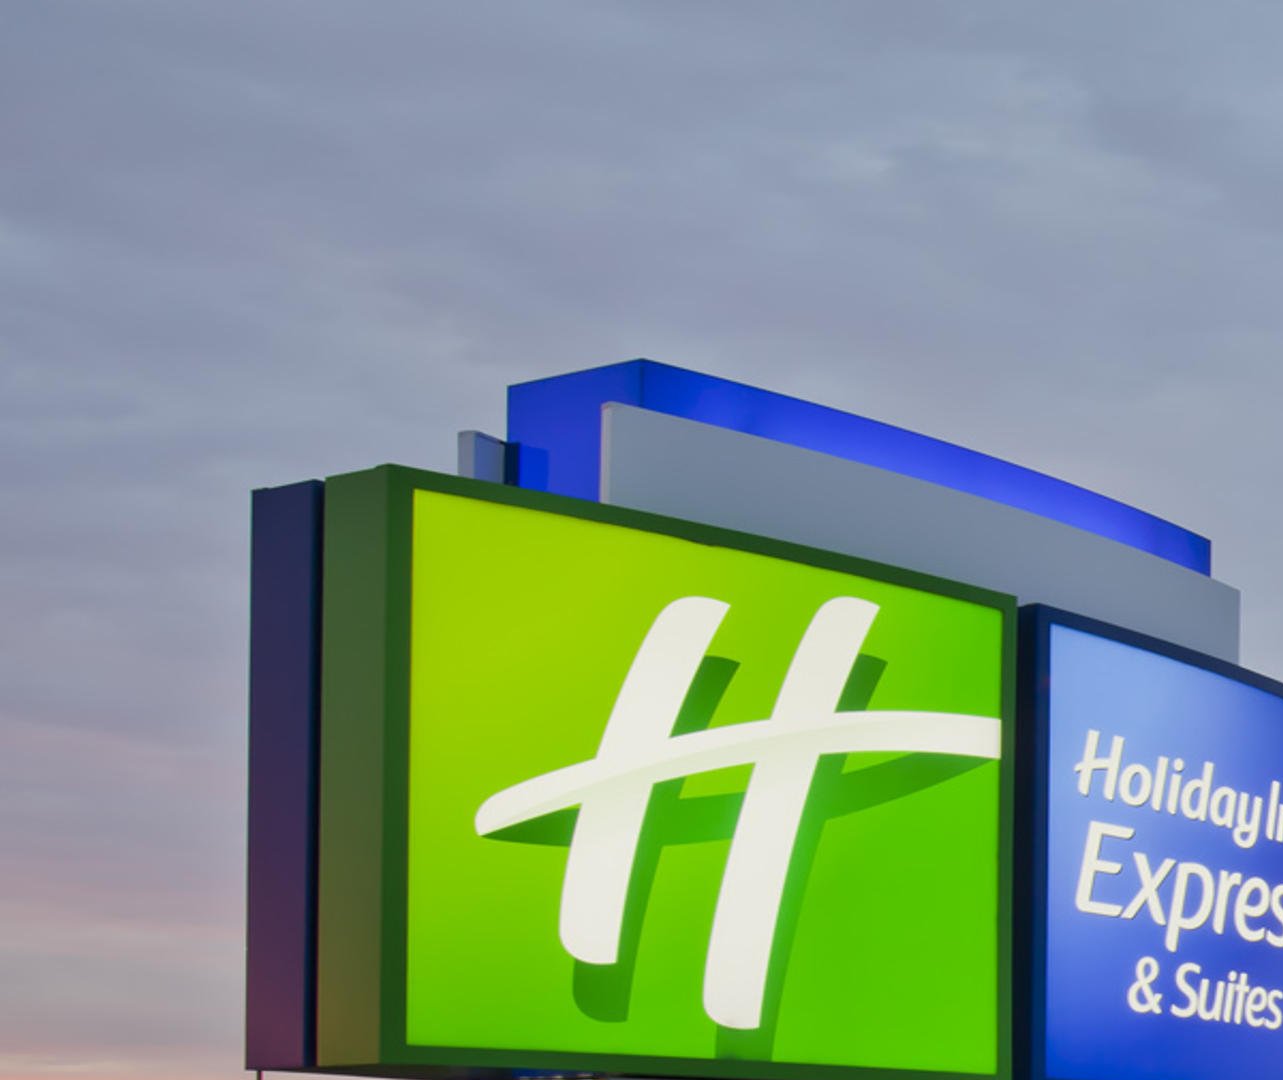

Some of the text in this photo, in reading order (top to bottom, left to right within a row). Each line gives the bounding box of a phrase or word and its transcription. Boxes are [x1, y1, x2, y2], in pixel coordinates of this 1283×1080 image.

[1073, 729, 1263, 849] Holiday
[1127, 956, 1283, 1029] & Suites
